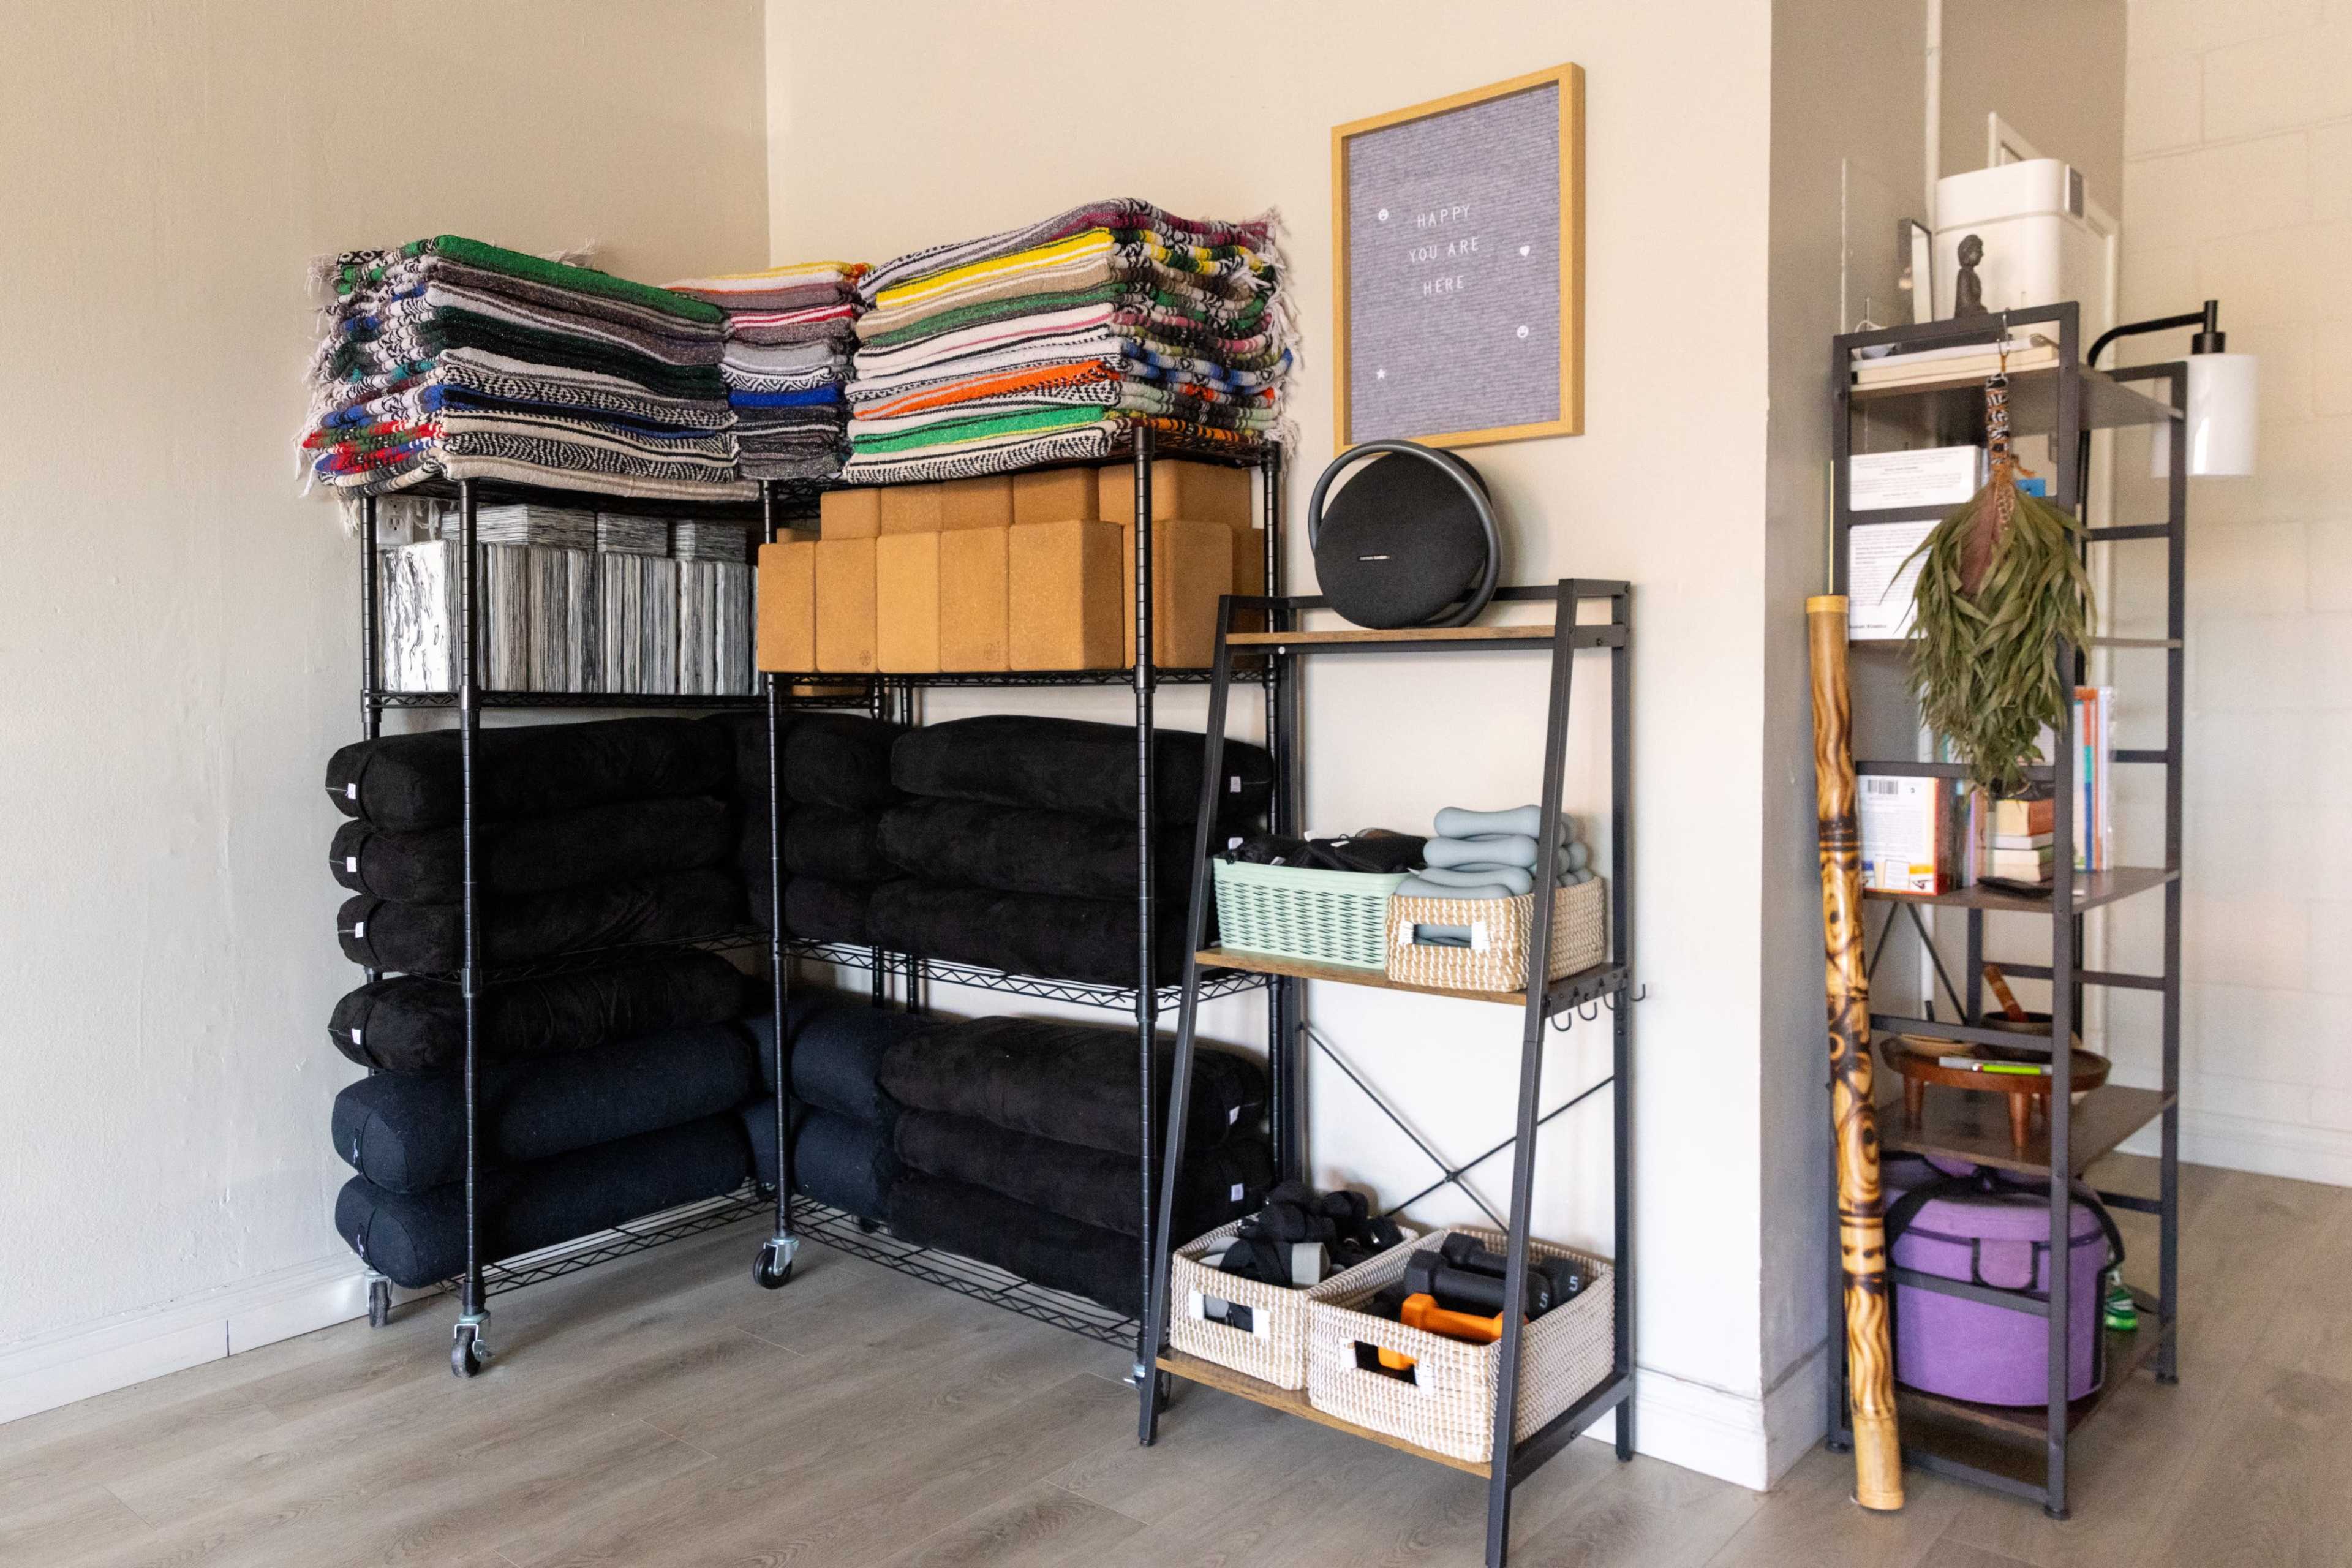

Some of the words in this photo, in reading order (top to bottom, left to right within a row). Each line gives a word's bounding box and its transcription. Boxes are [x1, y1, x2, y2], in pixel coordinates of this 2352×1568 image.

[1417, 205, 1469, 228] HAPPY
[1409, 245, 1438, 263] YOU
[1447, 236, 1479, 256] ARE
[1423, 276, 1464, 296] HERE
[1569, 1276, 1578, 1291] 5
[1540, 1292, 1549, 1308] 5
